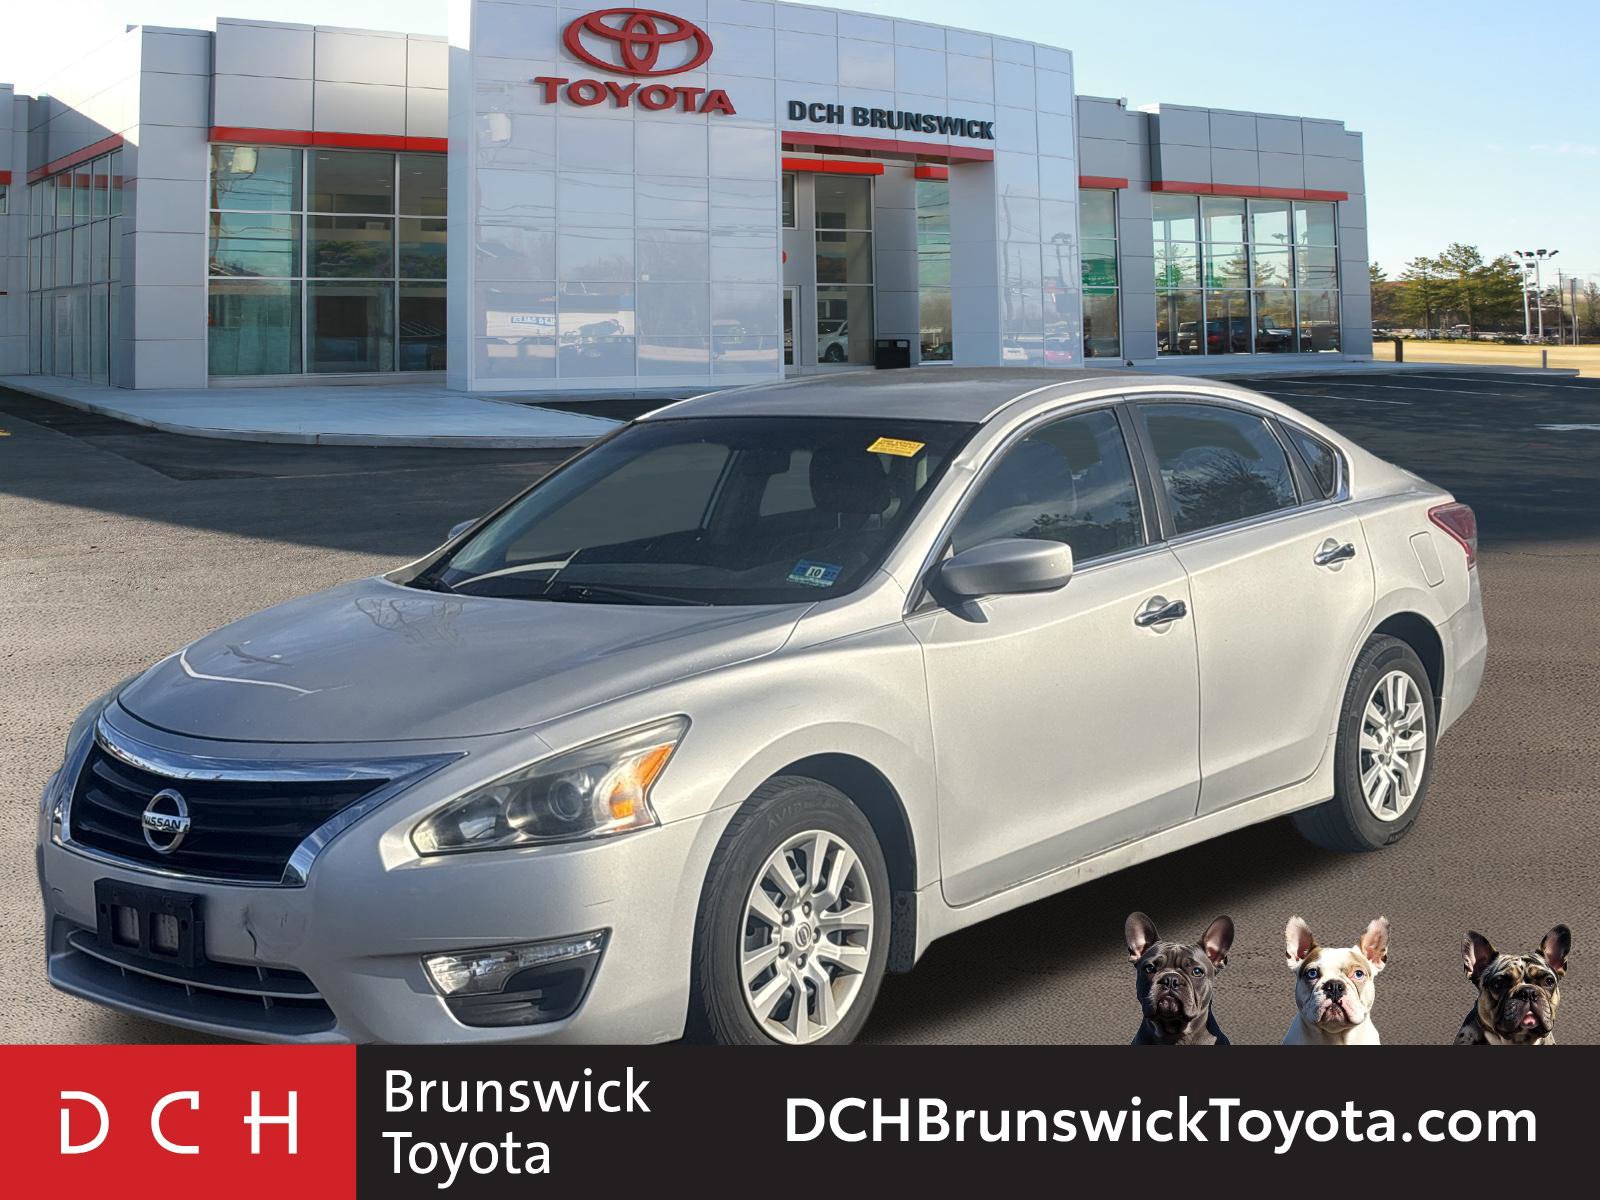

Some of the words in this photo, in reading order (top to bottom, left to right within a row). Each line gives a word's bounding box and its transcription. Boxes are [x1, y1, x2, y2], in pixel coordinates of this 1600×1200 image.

[534, 76, 736, 115] TOYOTA
[788, 100, 844, 125] DCH
[852, 106, 994, 140] BRUNSWICK
[809, 568, 821, 577] 10
